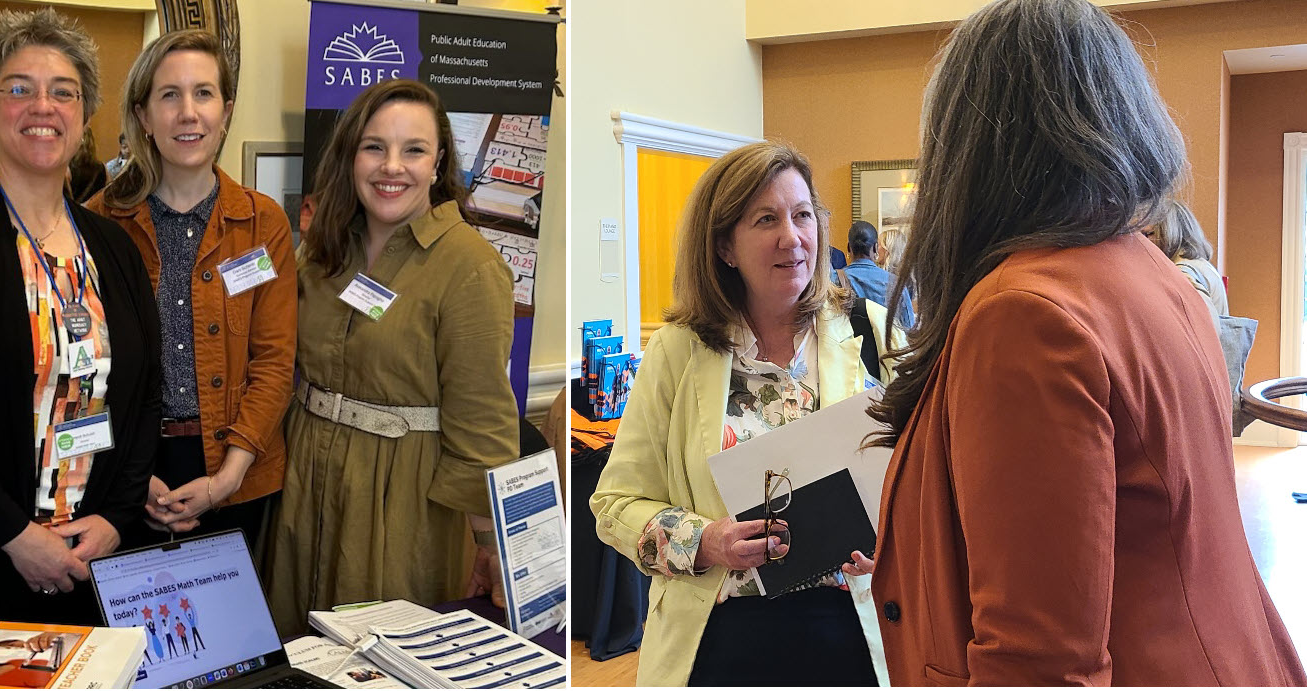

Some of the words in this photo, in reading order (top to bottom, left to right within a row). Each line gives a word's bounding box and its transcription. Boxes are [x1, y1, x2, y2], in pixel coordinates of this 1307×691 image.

[431, 34, 451, 46] Public
[453, 36, 471, 47] Adult
[472, 38, 507, 50] Education
[430, 54, 438, 64] of
[439, 55, 489, 67] Massachusetts
[430, 74, 471, 86] Professional
[472, 76, 517, 90] Development
[518, 79, 543, 90] System
[501, 122, 519, 132] 0.95
[490, 147, 518, 159] 1.413
[512, 255, 533, 270] 0.25
[505, 477, 519, 486] SABES
[519, 472, 535, 480] Program
[534, 467, 549, 475] Support
[512, 482, 524, 490] Team
[109, 597, 126, 608] How
[127, 593, 141, 603] can
[142, 589, 154, 600] the
[154, 584, 177, 597] SABES
[177, 580, 194, 592] Math
[194, 576, 213, 587] Team
[213, 573, 227, 585] help
[227, 570, 240, 581] you
[113, 607, 138, 621] today?
[57, 660, 83, 689] TEACHER
[78, 644, 98, 662] BOOK
